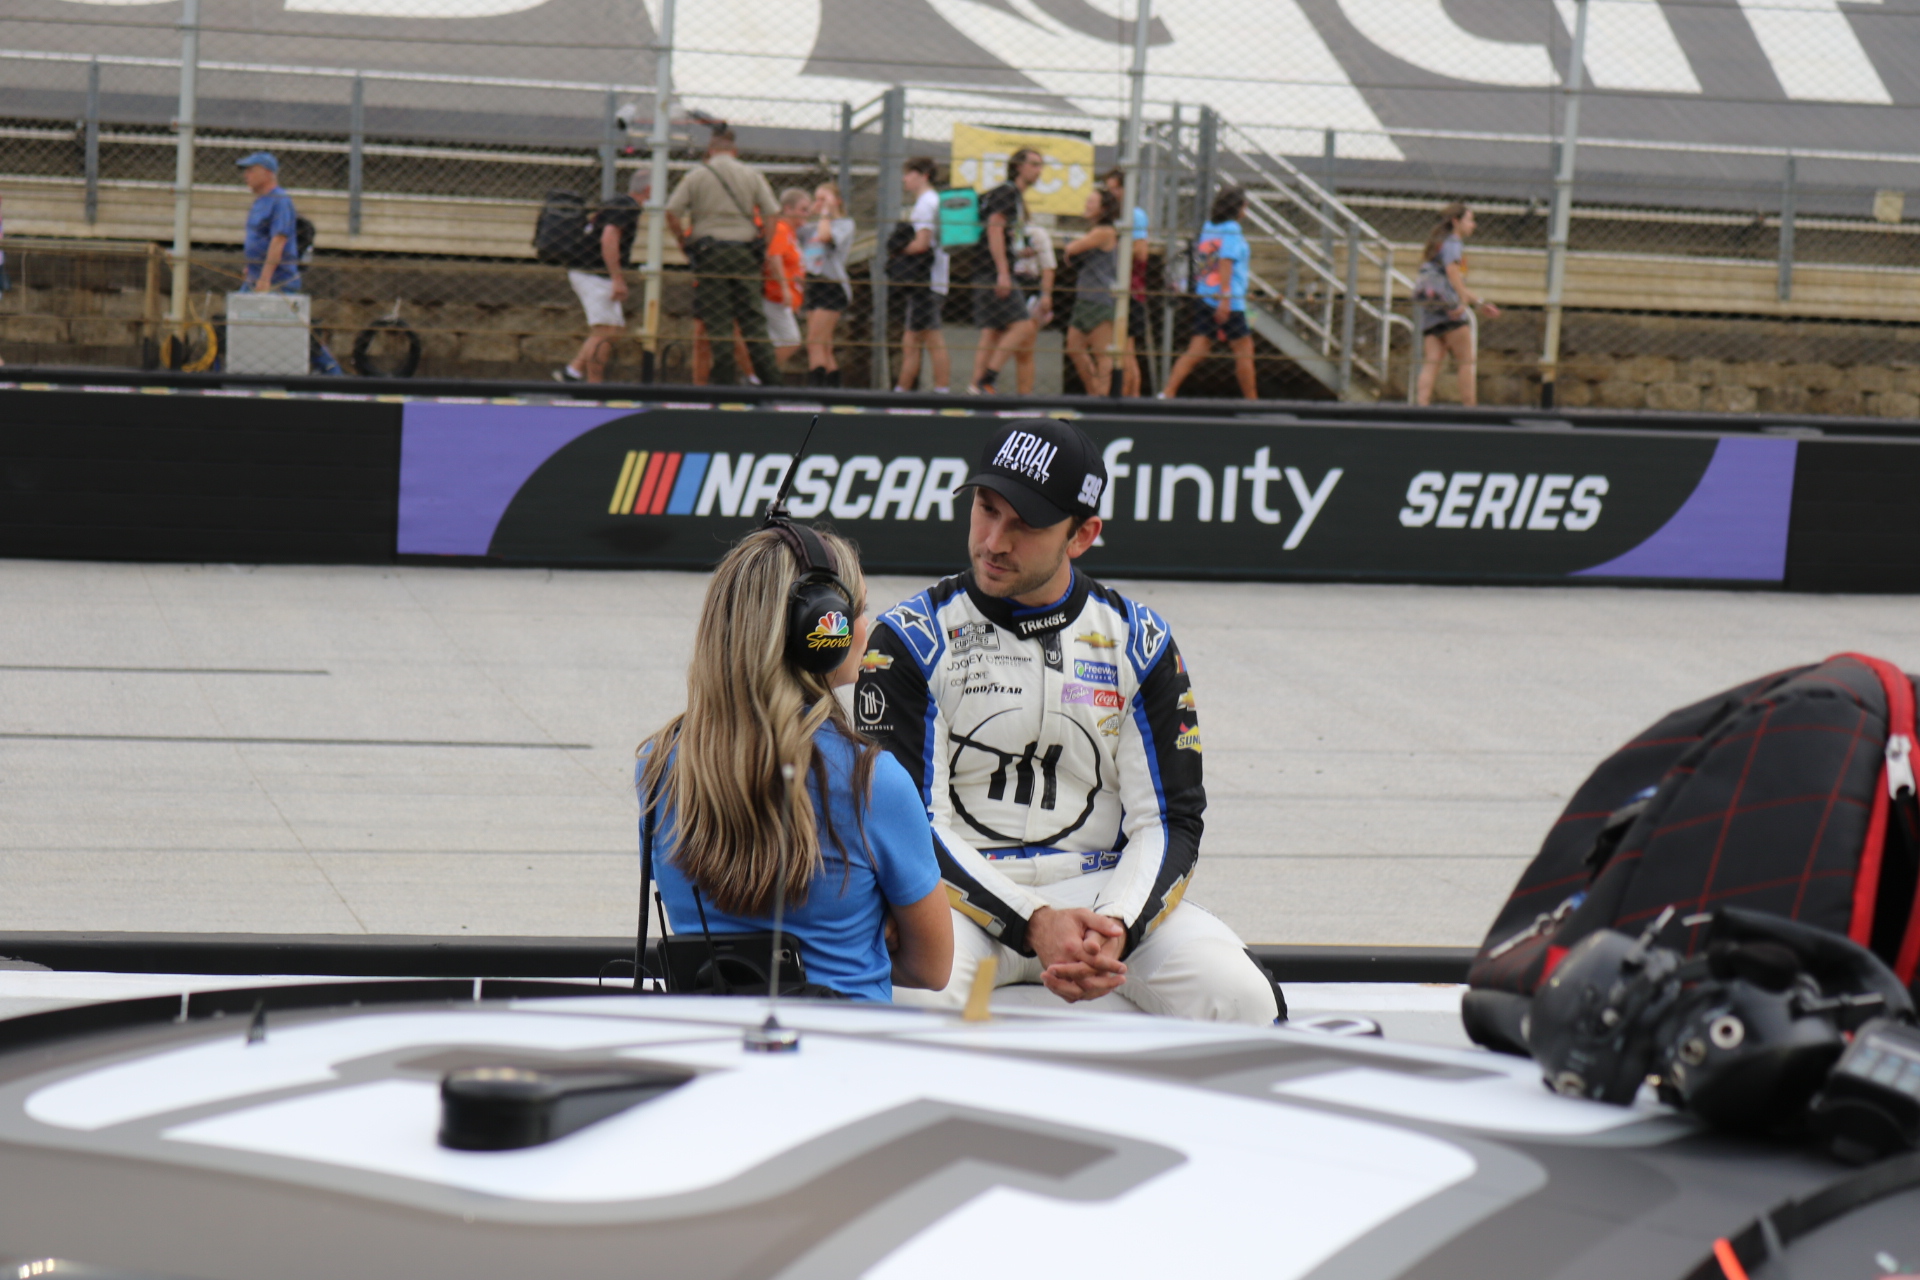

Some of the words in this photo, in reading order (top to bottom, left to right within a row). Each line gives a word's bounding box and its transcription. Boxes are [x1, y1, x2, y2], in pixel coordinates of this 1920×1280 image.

[997, 430, 1058, 478] AERIAL
[992, 456, 1049, 485] RECOVERY
[695, 452, 969, 521] NASCAR
[1093, 437, 1344, 550] finity
[1398, 470, 1609, 531] SERIES
[1077, 472, 1103, 508] 99
[1018, 611, 1067, 635] TRKHSE
[806, 632, 853, 651] Sports
[1084, 662, 1117, 679] Freewy
[964, 683, 1023, 695] OODYEAR
[1178, 735, 1200, 747] SUN
